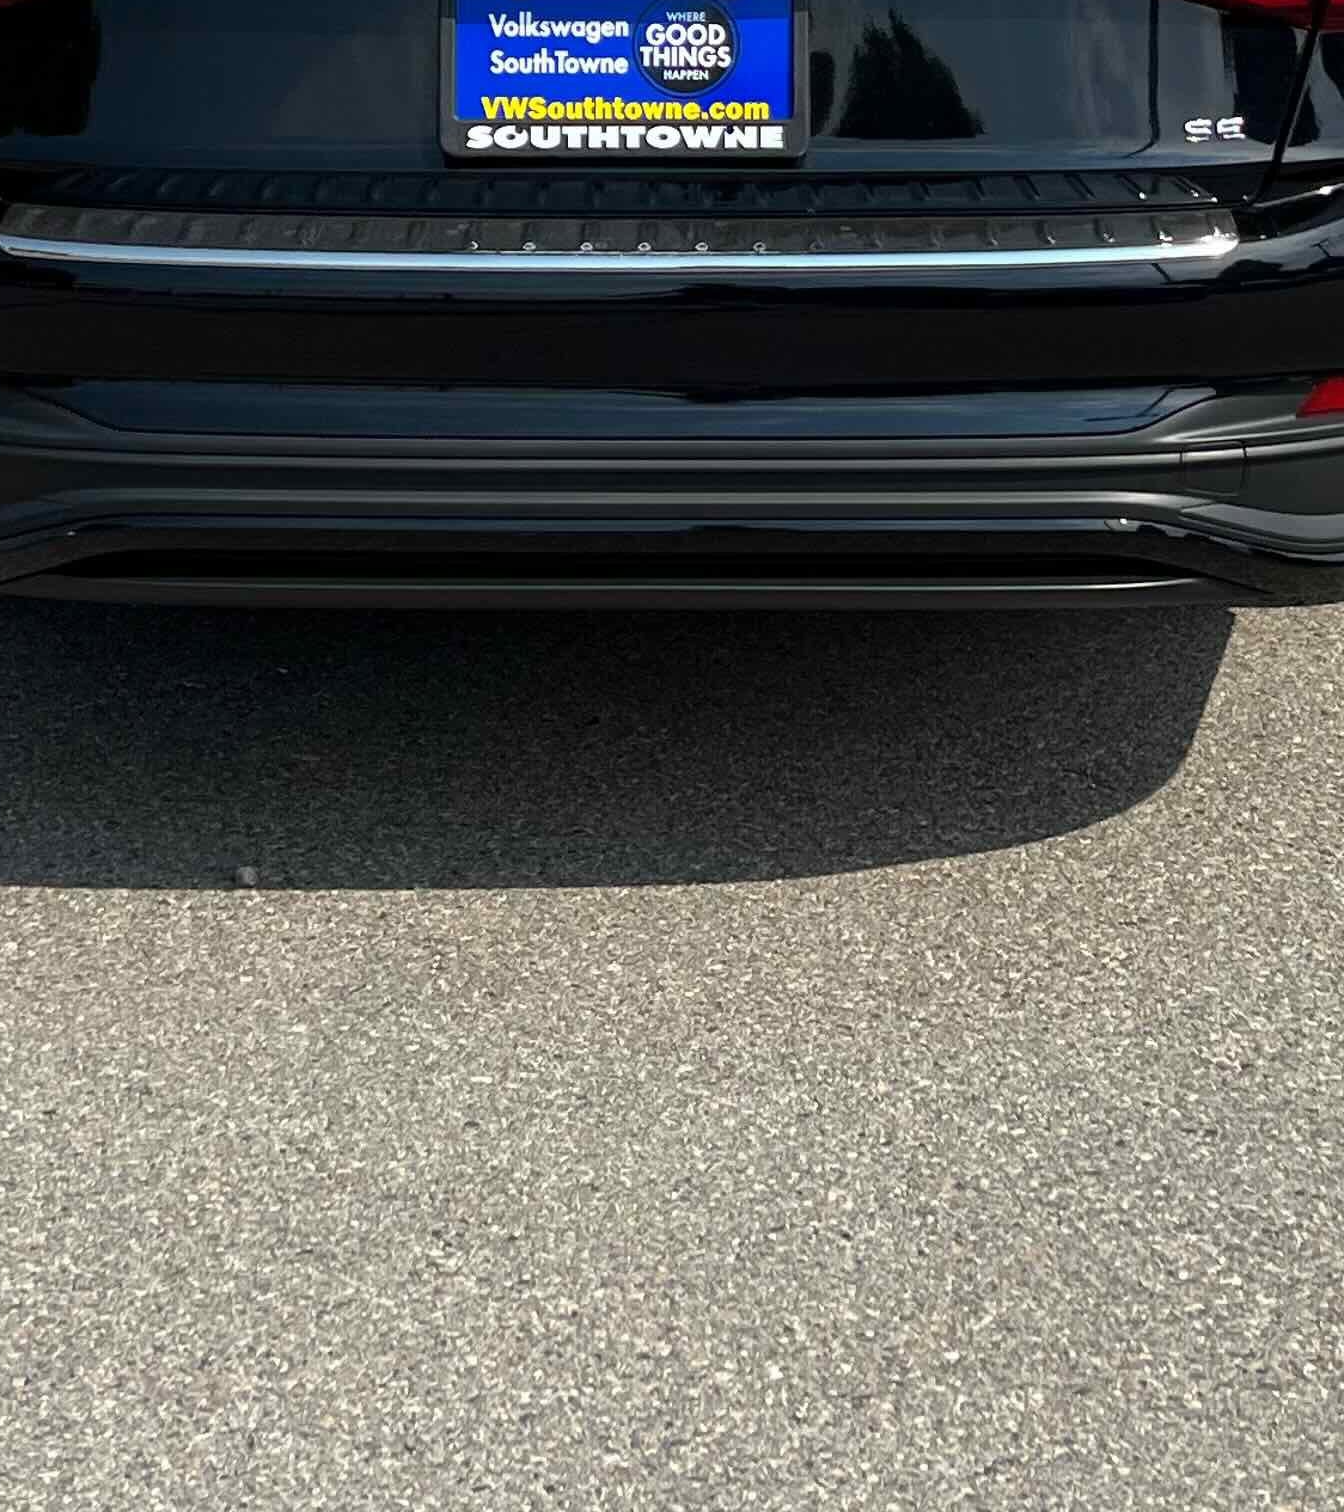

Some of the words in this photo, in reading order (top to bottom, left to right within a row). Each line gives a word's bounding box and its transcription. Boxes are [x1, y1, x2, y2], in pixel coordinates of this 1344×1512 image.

[489, 13, 629, 43] Volkswagen
[666, 12, 706, 23] WHERE
[646, 23, 726, 46] GOOD
[489, 50, 629, 74] SouthTowne
[640, 45, 732, 68] THINGS
[663, 69, 709, 81] HAPPEN
[481, 96, 770, 121] VWSouthtowne.com
[466, 125, 785, 149] SOUTHTOWNE
